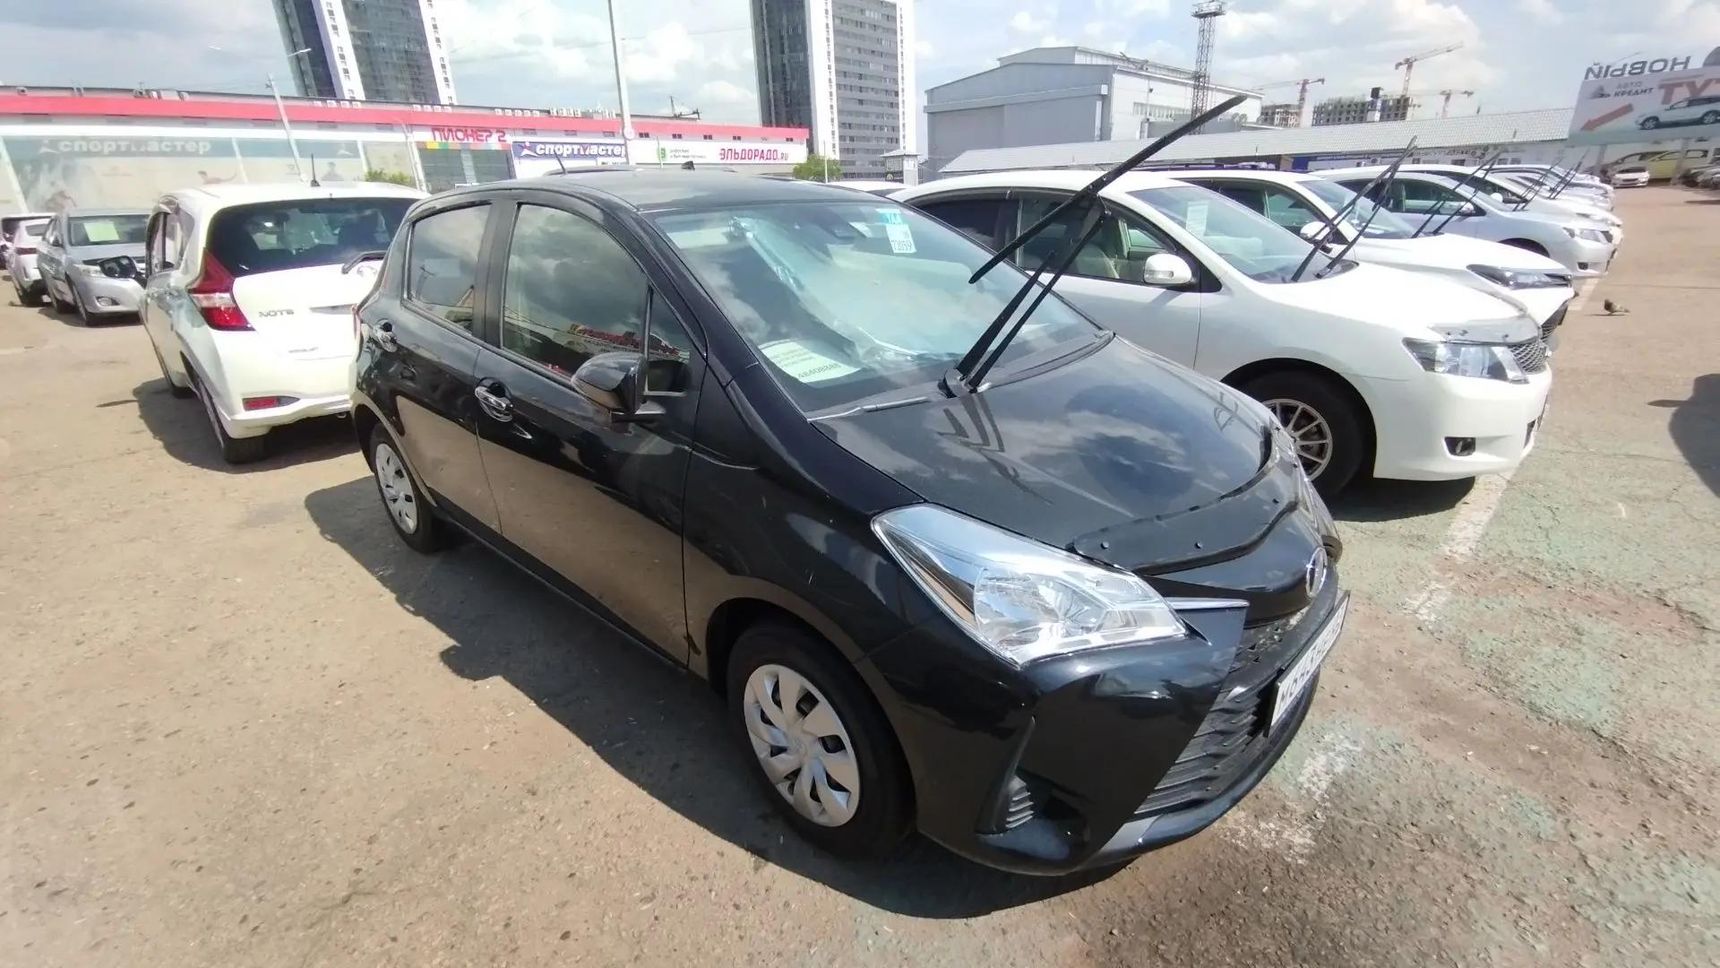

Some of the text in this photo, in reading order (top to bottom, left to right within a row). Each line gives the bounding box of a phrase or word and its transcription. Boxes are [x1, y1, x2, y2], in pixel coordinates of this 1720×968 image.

[1658, 78, 1720, 105] ТУ
[432, 127, 507, 143] ПИОНЕР 2
[258, 308, 294, 318] NOTE
